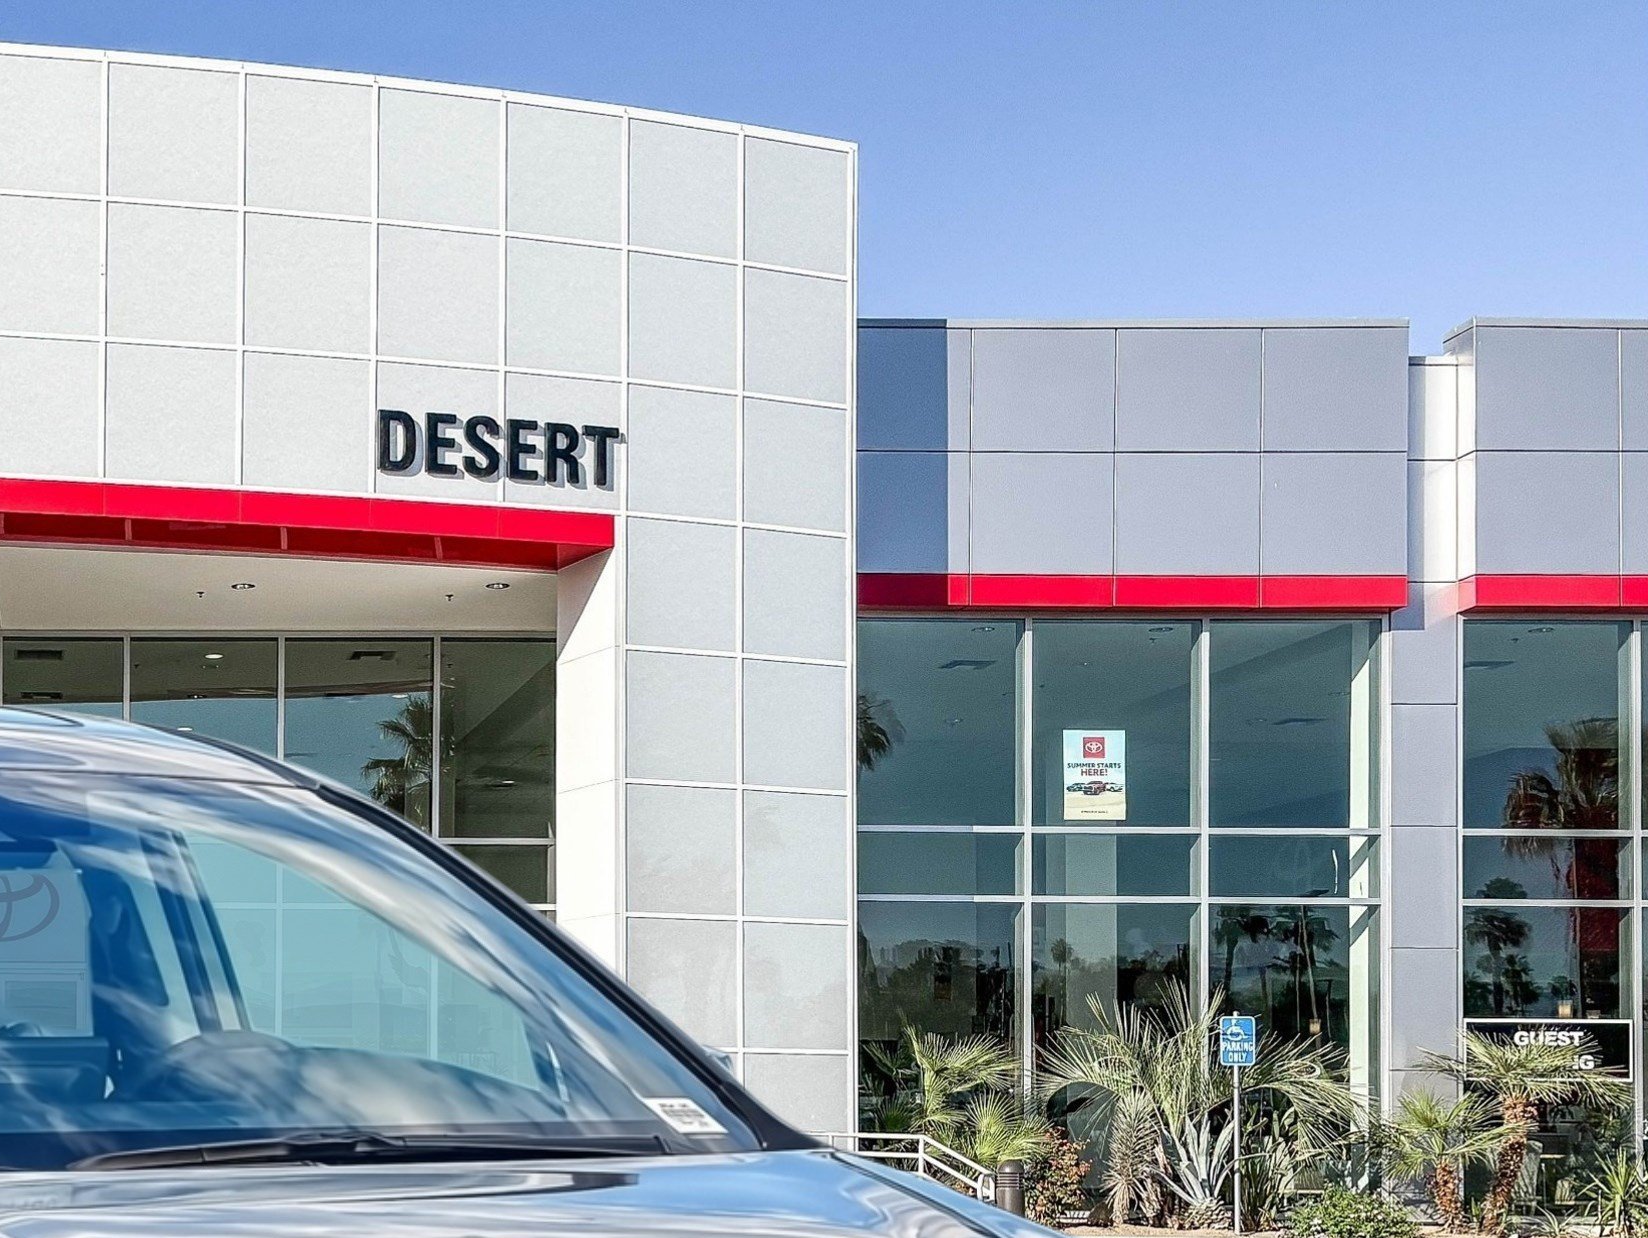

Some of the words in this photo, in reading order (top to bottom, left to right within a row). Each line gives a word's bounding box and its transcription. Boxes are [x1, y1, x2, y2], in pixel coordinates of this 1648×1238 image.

[377, 409, 620, 487] DESERT
[1080, 768, 1108, 776] HERE!
[1513, 1030, 1584, 1046] GUEST
[1222, 1041, 1254, 1051] PARKING
[1228, 1051, 1247, 1062] ONLY
